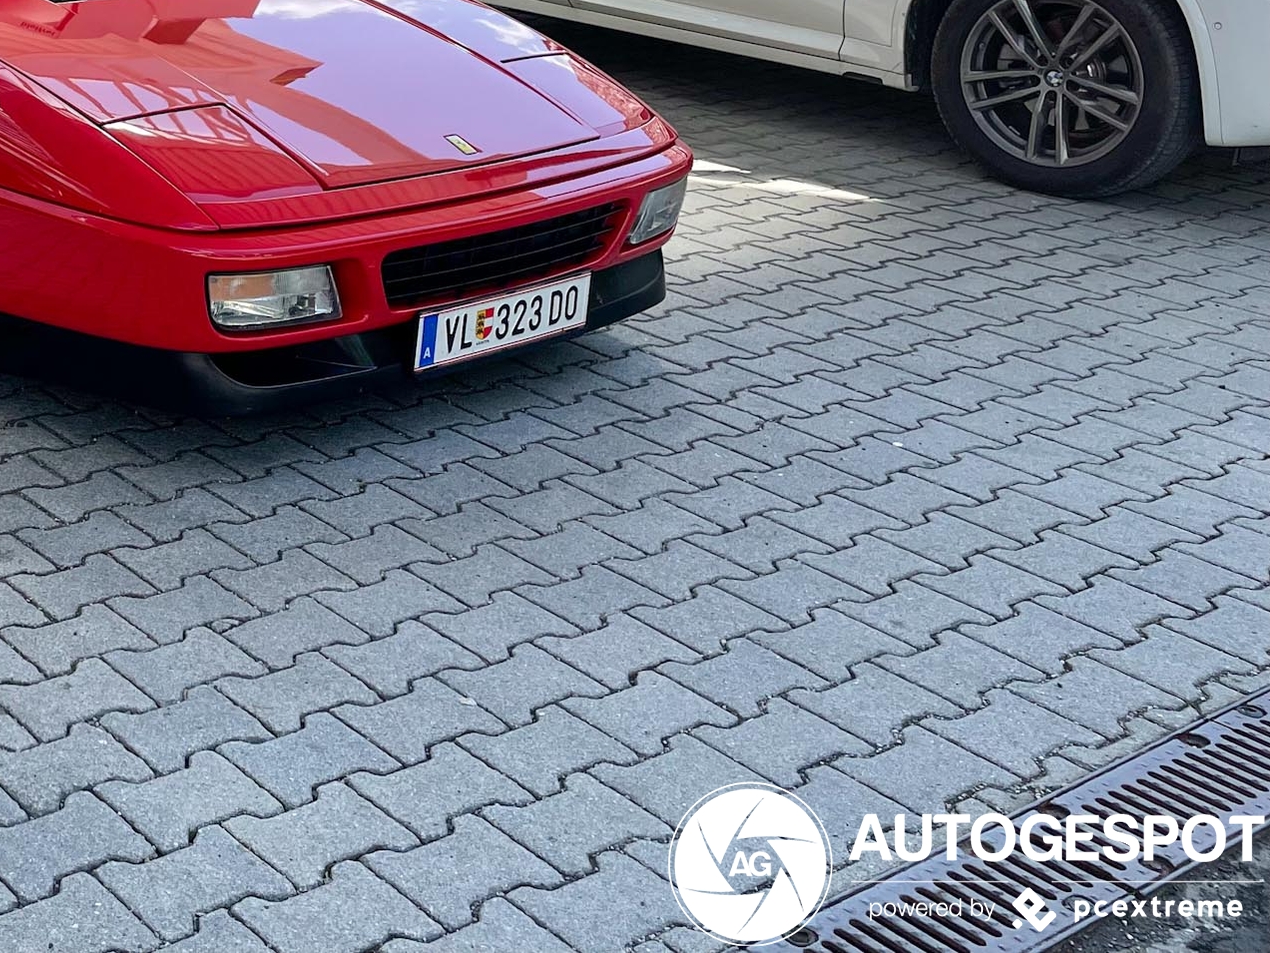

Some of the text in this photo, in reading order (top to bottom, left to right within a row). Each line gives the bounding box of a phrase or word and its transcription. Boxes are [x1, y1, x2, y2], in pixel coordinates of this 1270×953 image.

[445, 313, 473, 353] VL
[495, 294, 543, 340] 323
[422, 347, 431, 359] A
